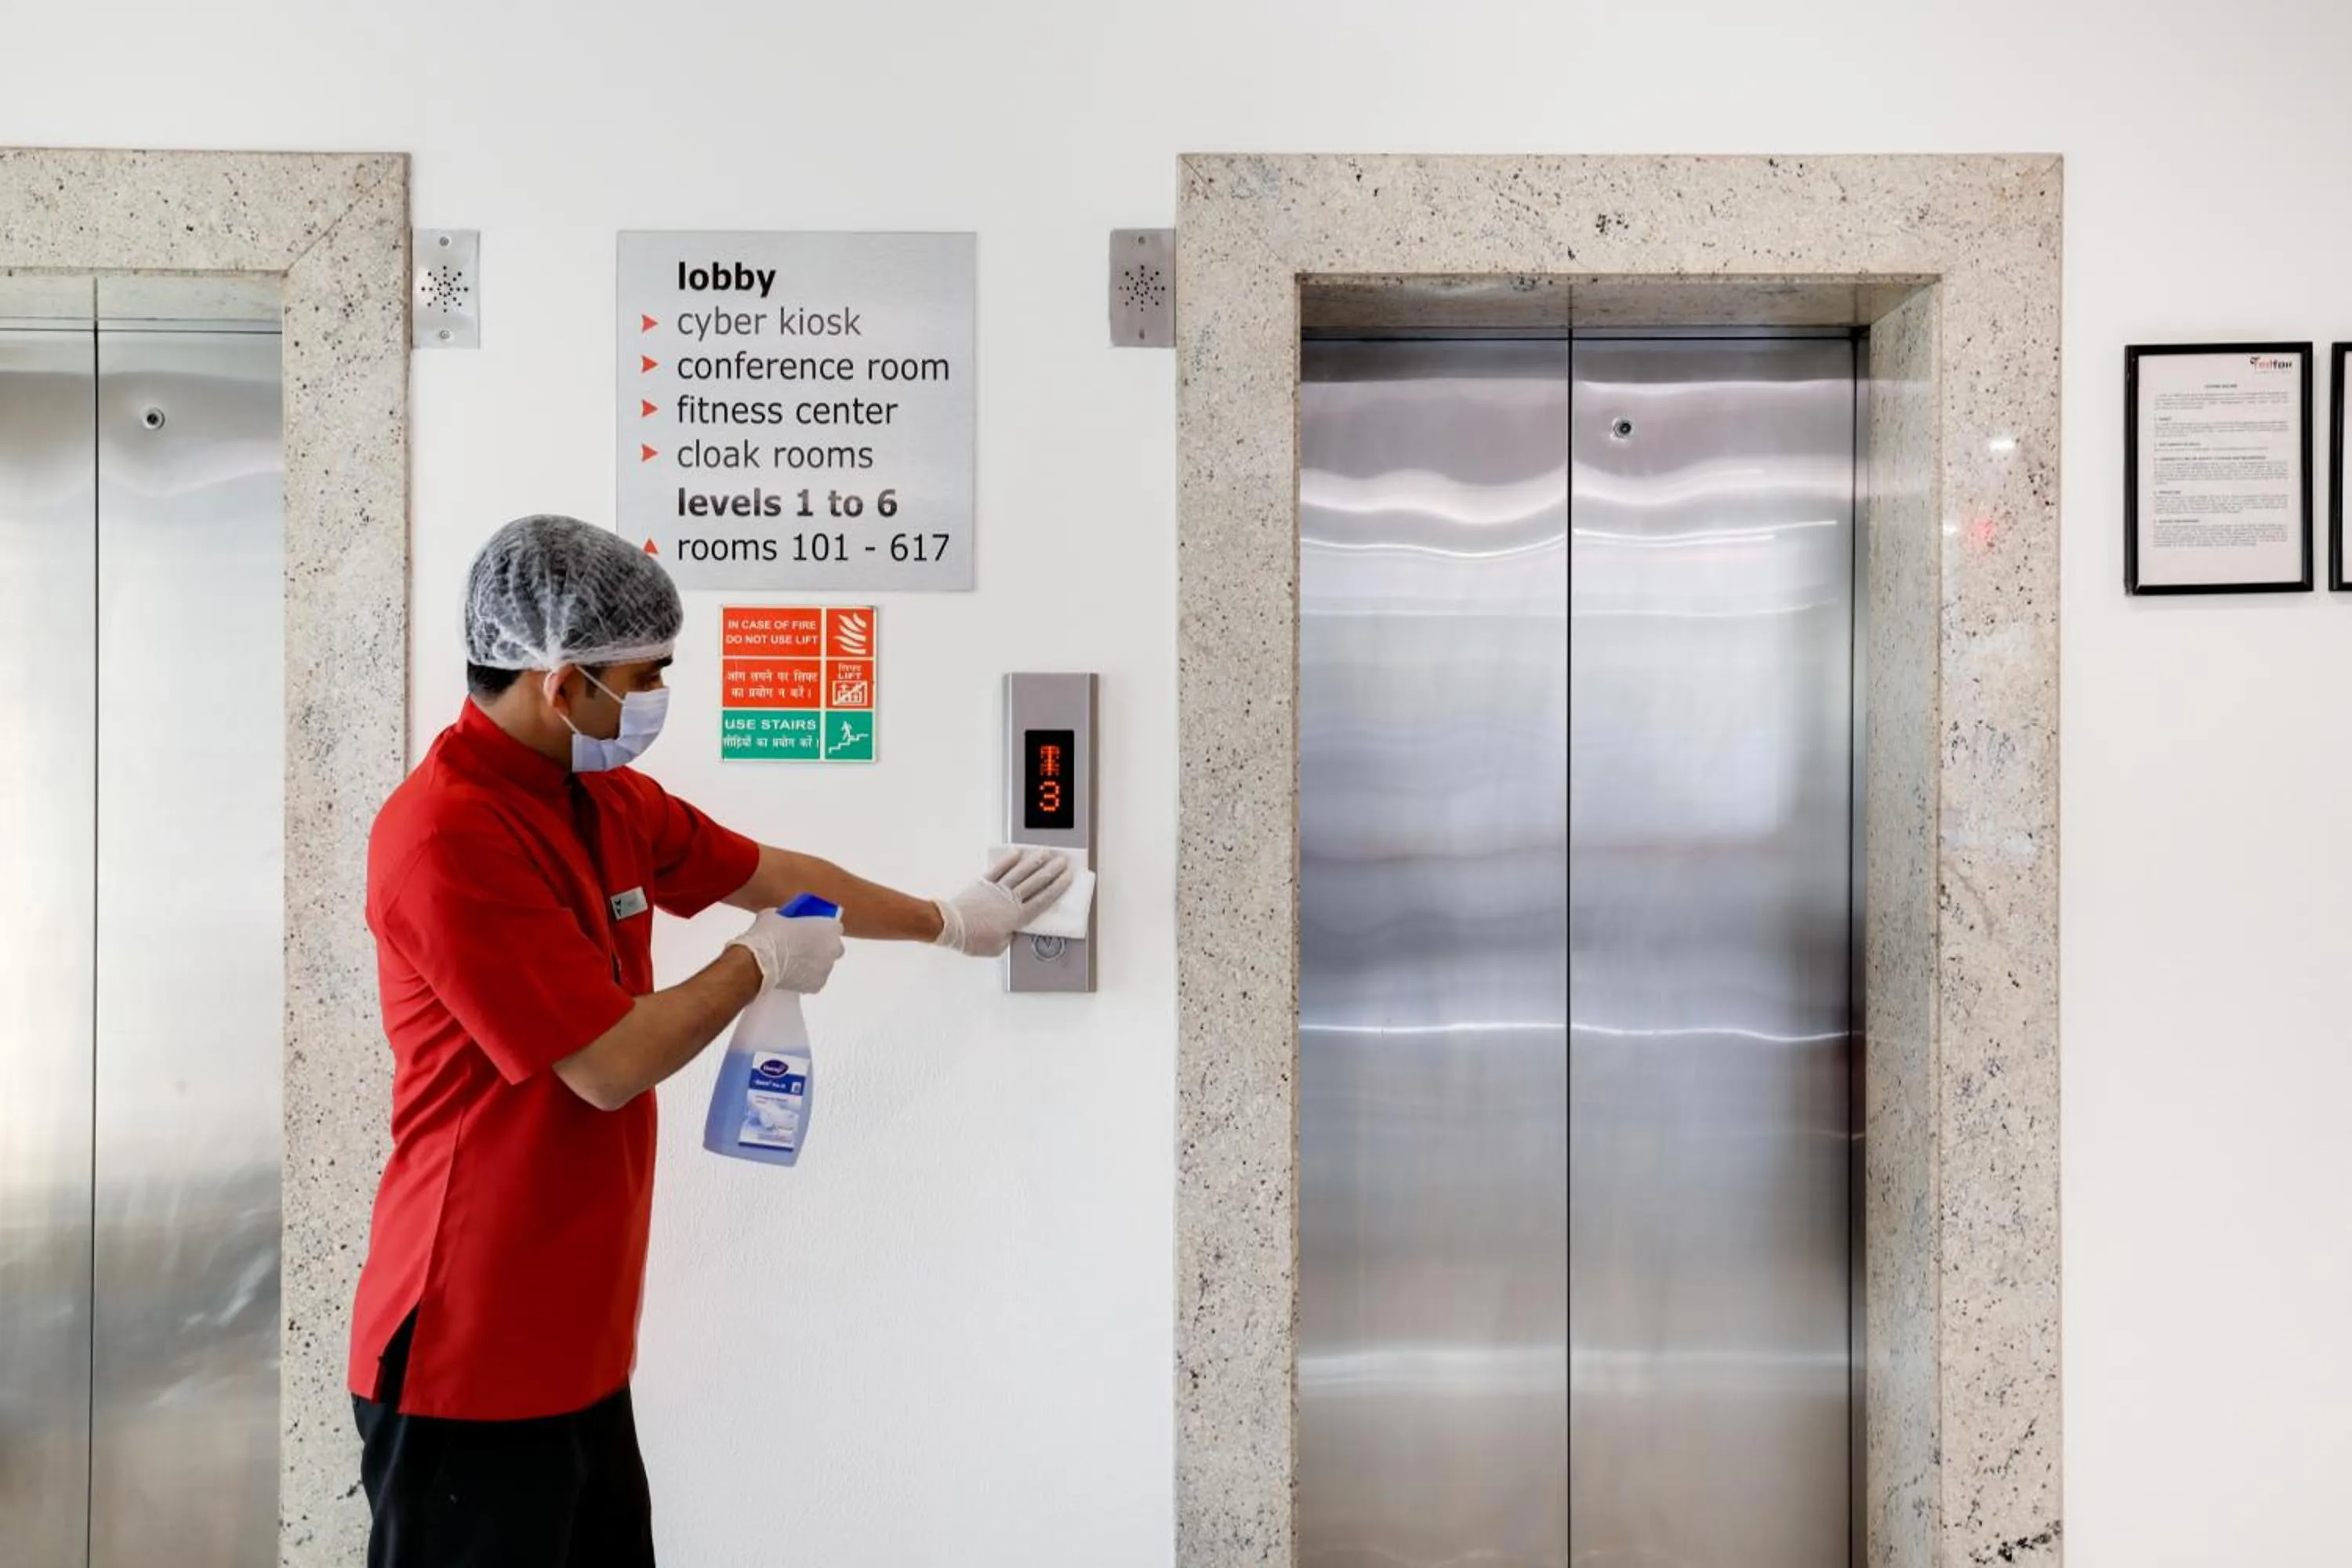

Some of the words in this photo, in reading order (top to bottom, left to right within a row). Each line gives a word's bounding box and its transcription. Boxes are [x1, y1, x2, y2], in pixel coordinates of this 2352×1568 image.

[679, 262, 775, 298] lobby
[678, 306, 767, 341] cyber
[781, 307, 860, 336] kiosk
[678, 351, 853, 380] conference
[869, 359, 949, 380] room
[677, 395, 782, 423] fitness
[797, 398, 898, 424] center
[678, 439, 760, 468] cloak
[775, 447, 873, 468] rooms
[679, 488, 781, 517] levels
[797, 489, 813, 517] 1
[828, 491, 863, 517] to
[878, 489, 897, 517] 6
[679, 539, 777, 561] rooms
[793, 533, 848, 561] 101
[891, 533, 949, 561] 617
[725, 634, 743, 644] DO
[744, 634, 767, 644] NOT
[770, 634, 793, 644] USE
[794, 635, 818, 644] LIFT
[728, 619, 739, 630] IN
[741, 619, 771, 630] CASE
[773, 620, 790, 630] OF
[792, 620, 816, 630] FIRE
[837, 671, 862, 680] LIFT
[724, 719, 756, 730] USE
[760, 719, 816, 731] STAIRS
[1039, 781, 1061, 812] 3
